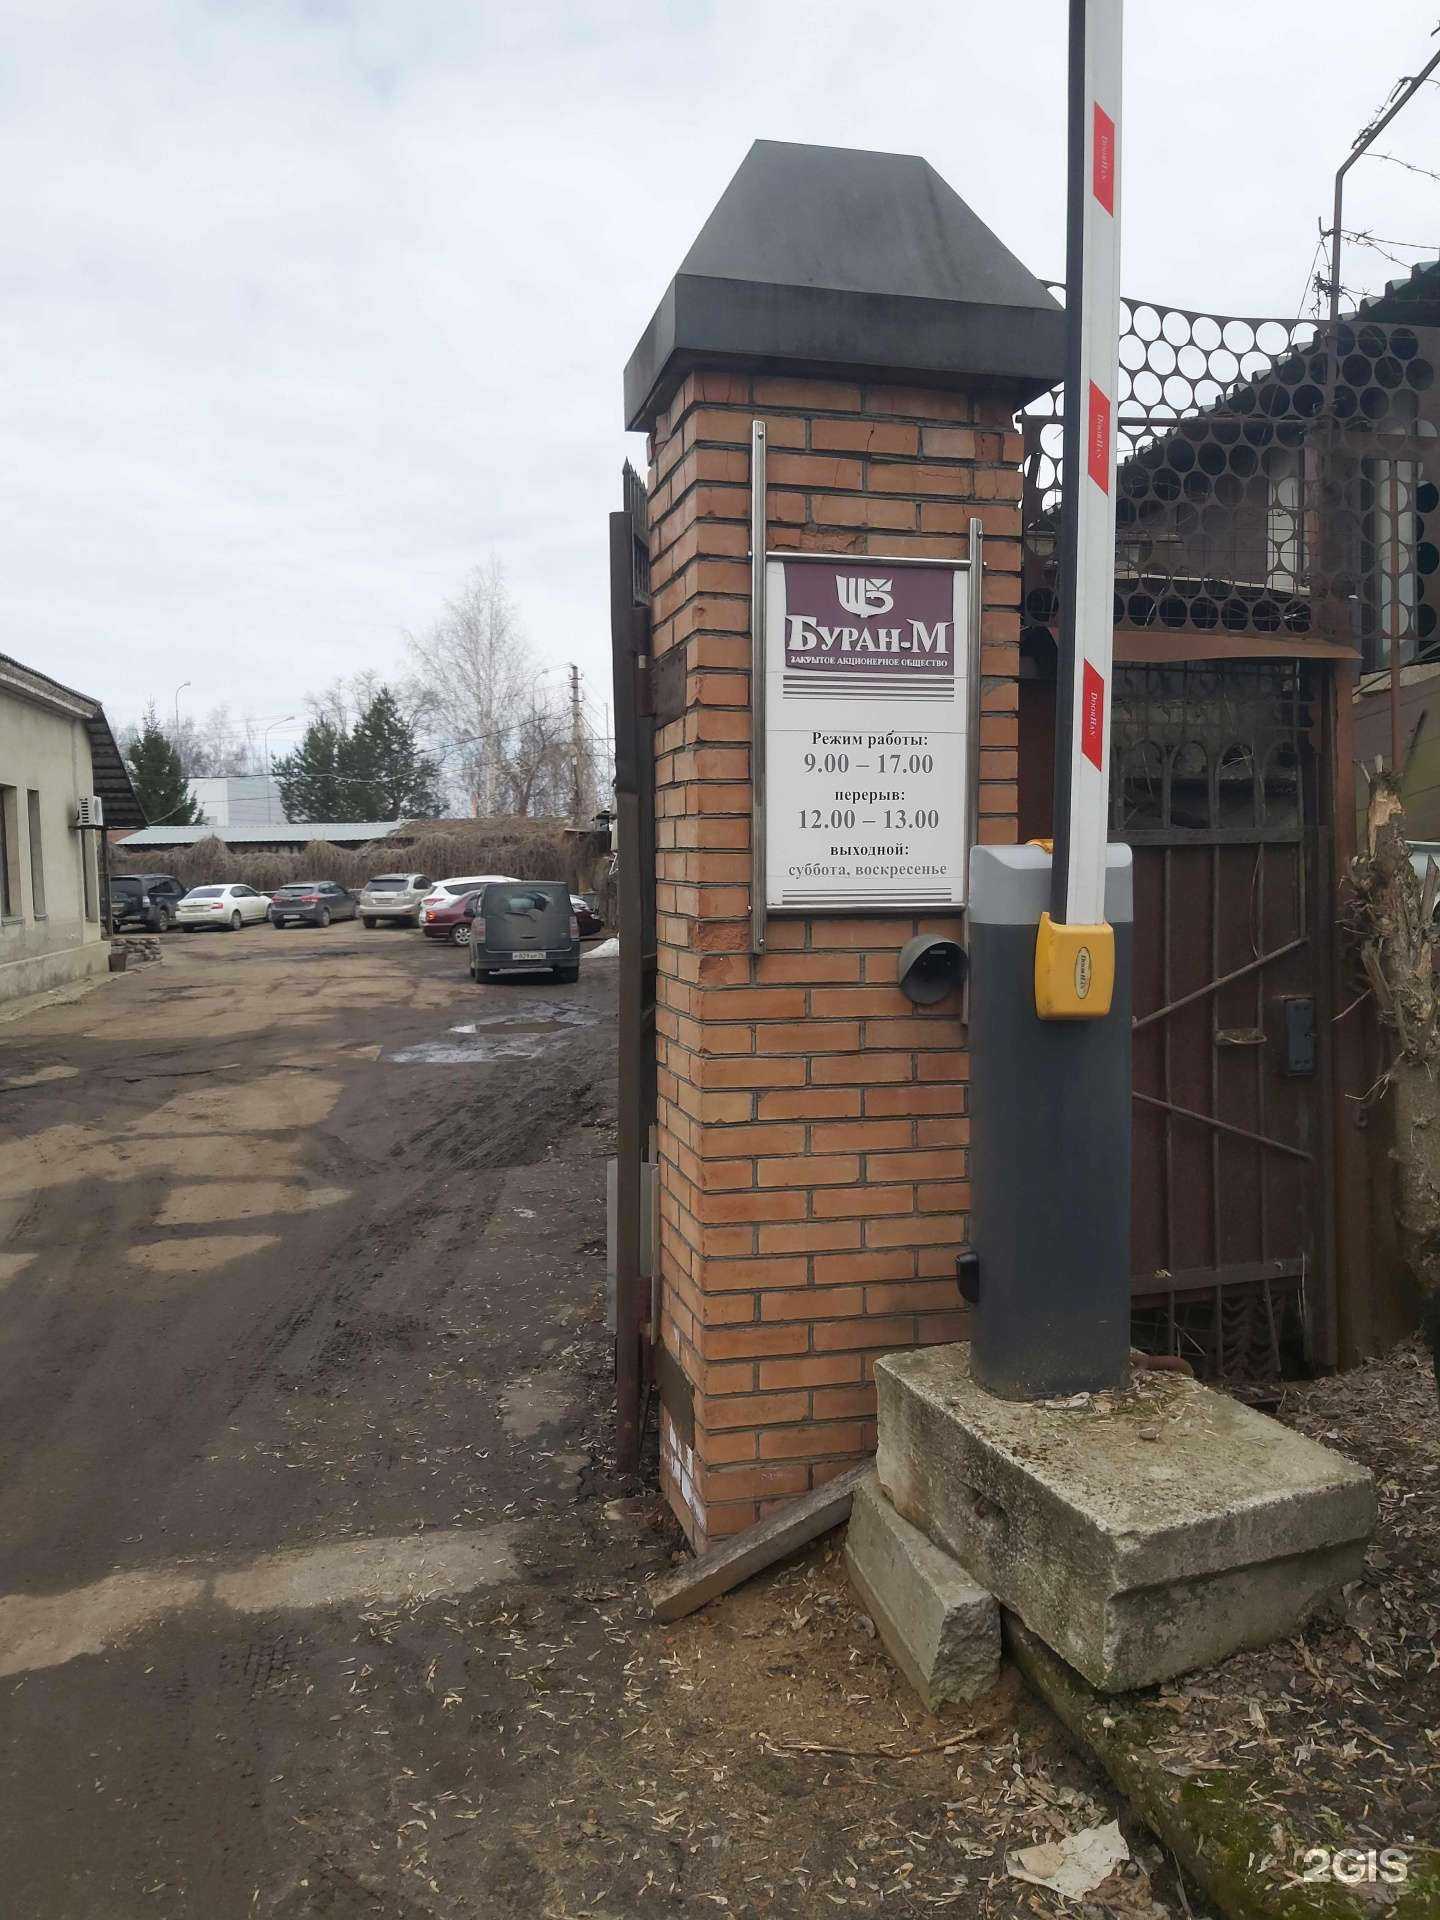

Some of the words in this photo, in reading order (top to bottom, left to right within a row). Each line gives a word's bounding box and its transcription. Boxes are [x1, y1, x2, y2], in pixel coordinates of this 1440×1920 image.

[790, 655, 836, 666] ЗАКРЫТОЕ
[836, 657, 900, 667] АКЦИОНЕРНОЕ
[901, 658, 948, 668] ОБЩЕСТВО
[811, 731, 863, 746] Режим
[868, 729, 929, 748] работы:
[803, 753, 850, 774] 9.00
[877, 754, 934, 774] 17.00
[834, 790, 906, 804] перерыв:
[798, 809, 856, 829] 12.00
[883, 809, 940, 829] 13.00
[830, 842, 910, 857] выходной:
[788, 863, 851, 880] суббота,
[855, 864, 947, 879] воскресенье
